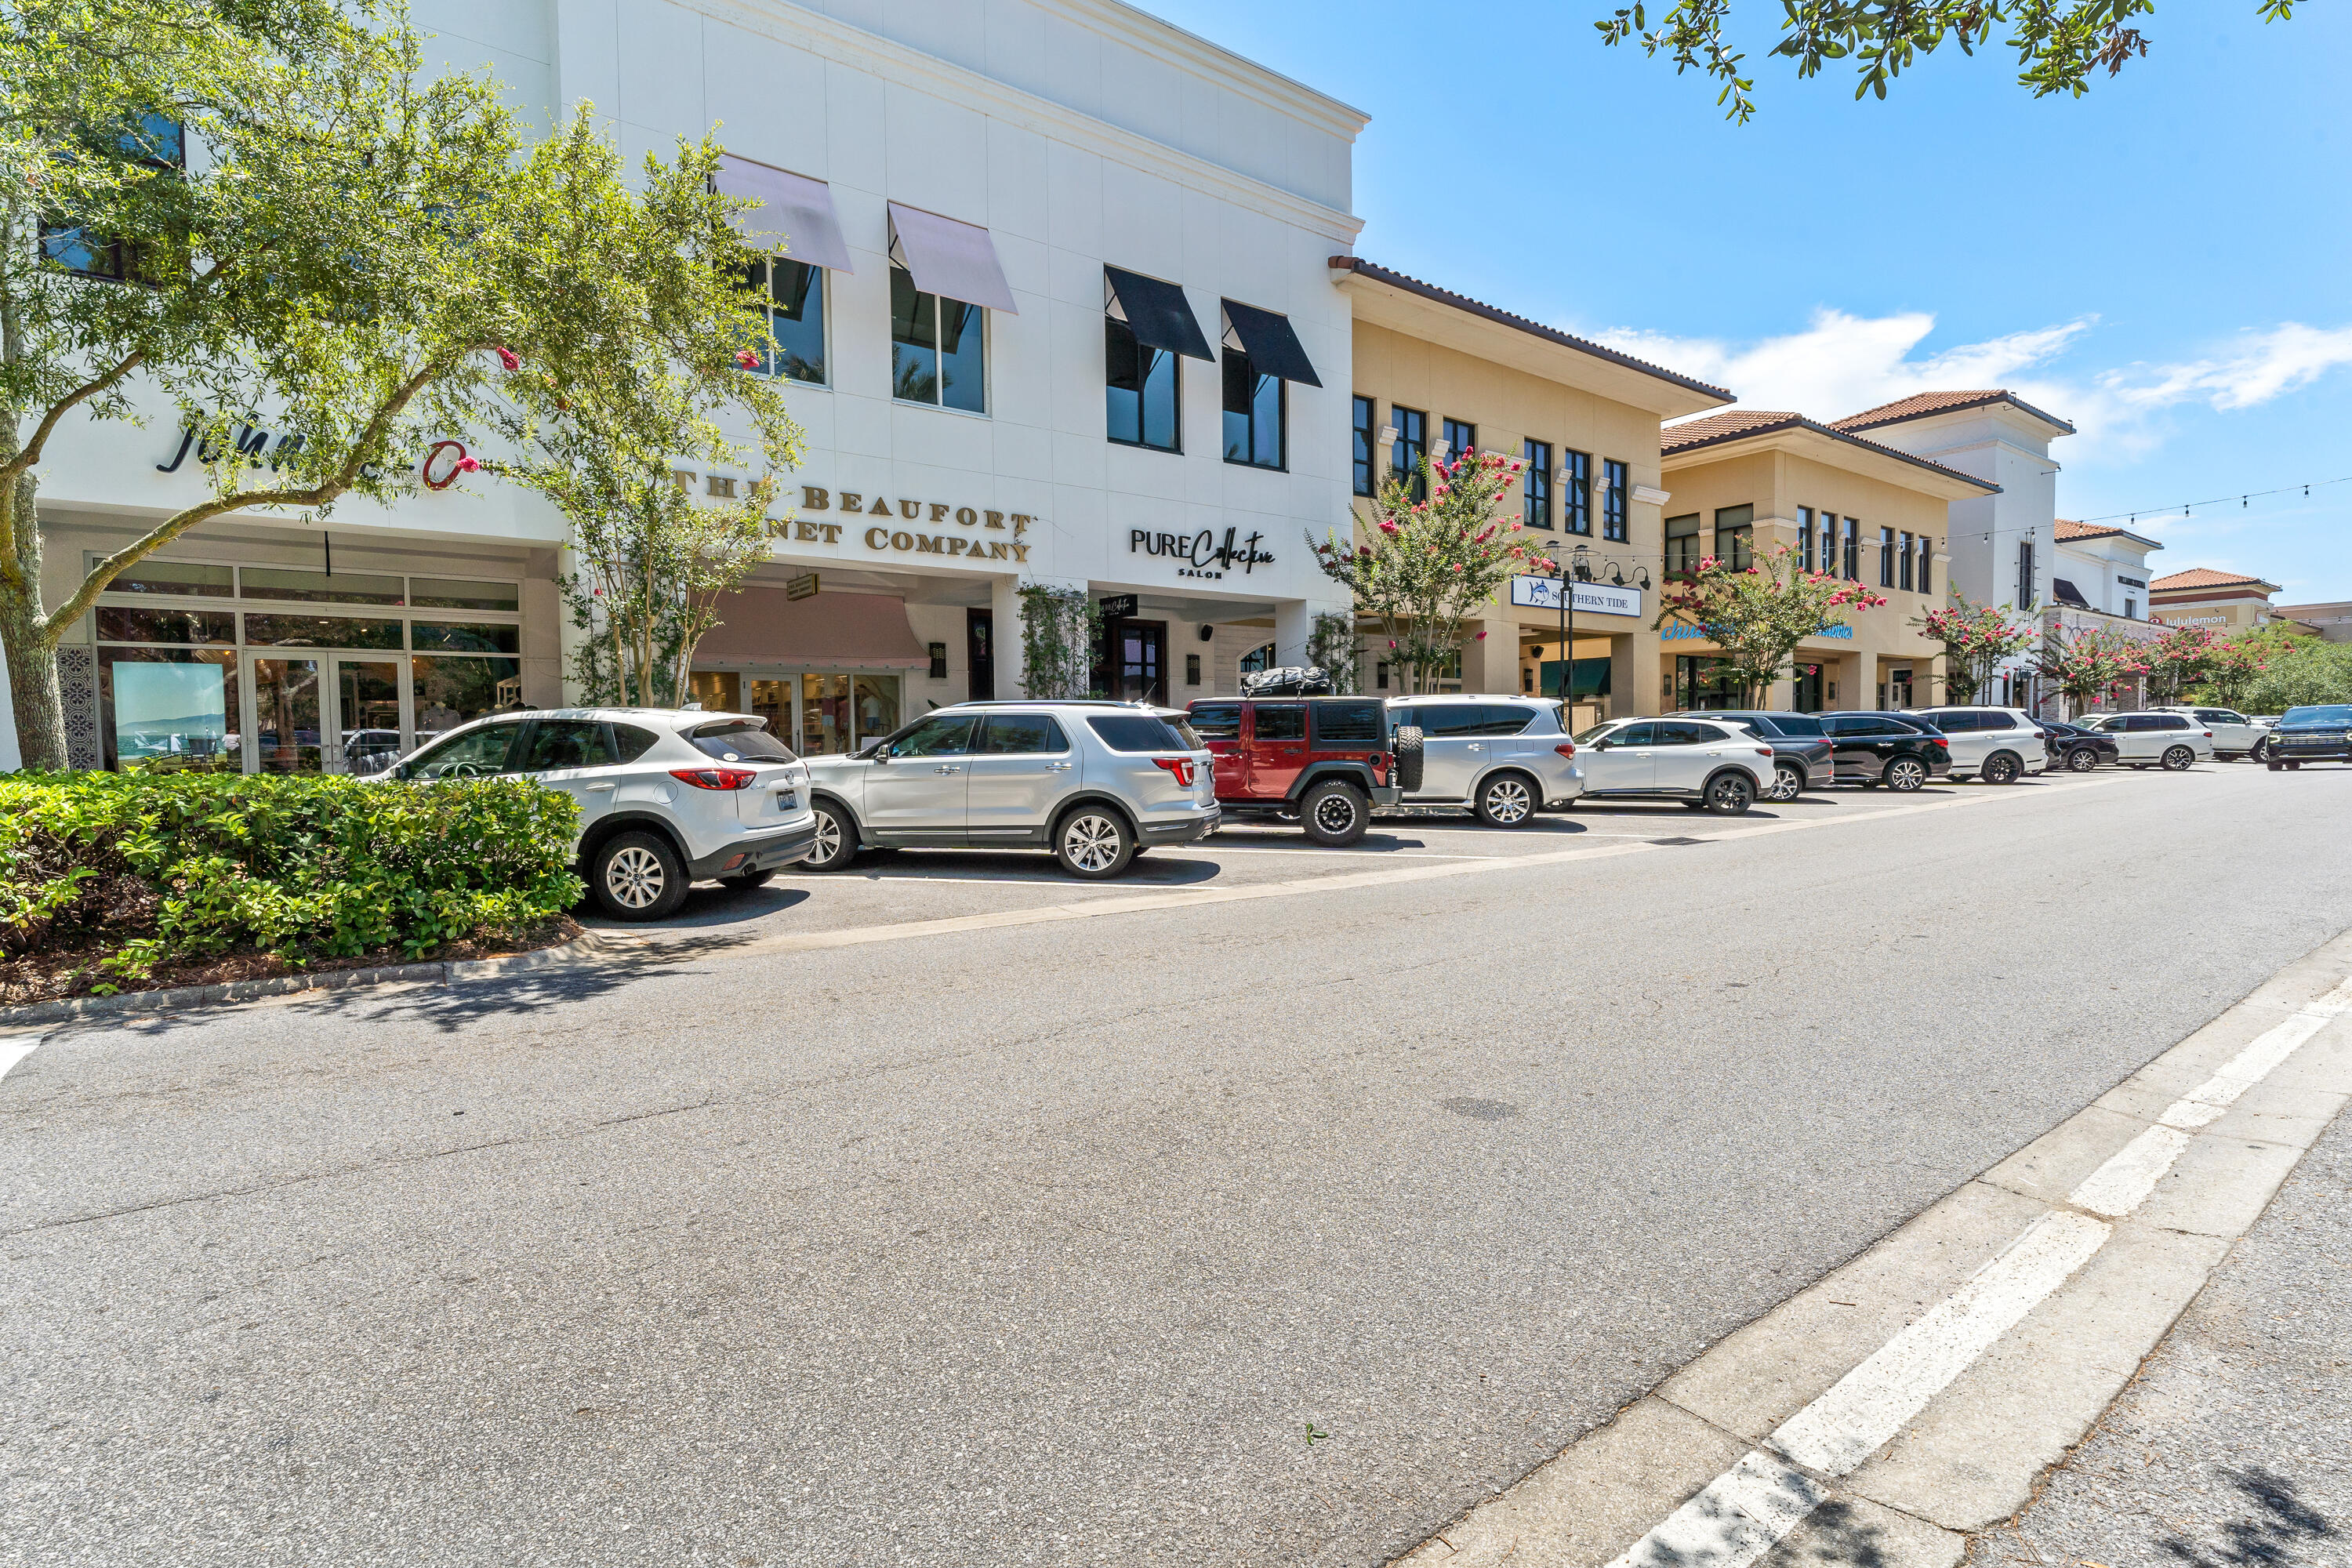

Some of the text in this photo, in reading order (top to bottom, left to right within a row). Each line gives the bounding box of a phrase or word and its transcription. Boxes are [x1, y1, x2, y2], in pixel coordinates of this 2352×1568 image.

[801, 485, 1031, 532] BEAUFORT
[865, 527, 1032, 562] COMPANY
[1131, 526, 1276, 575] PURE Collective
[1178, 568, 1222, 579] SALON
[1606, 597, 1628, 608] TIDE
[2166, 615, 2227, 626] lululemon
